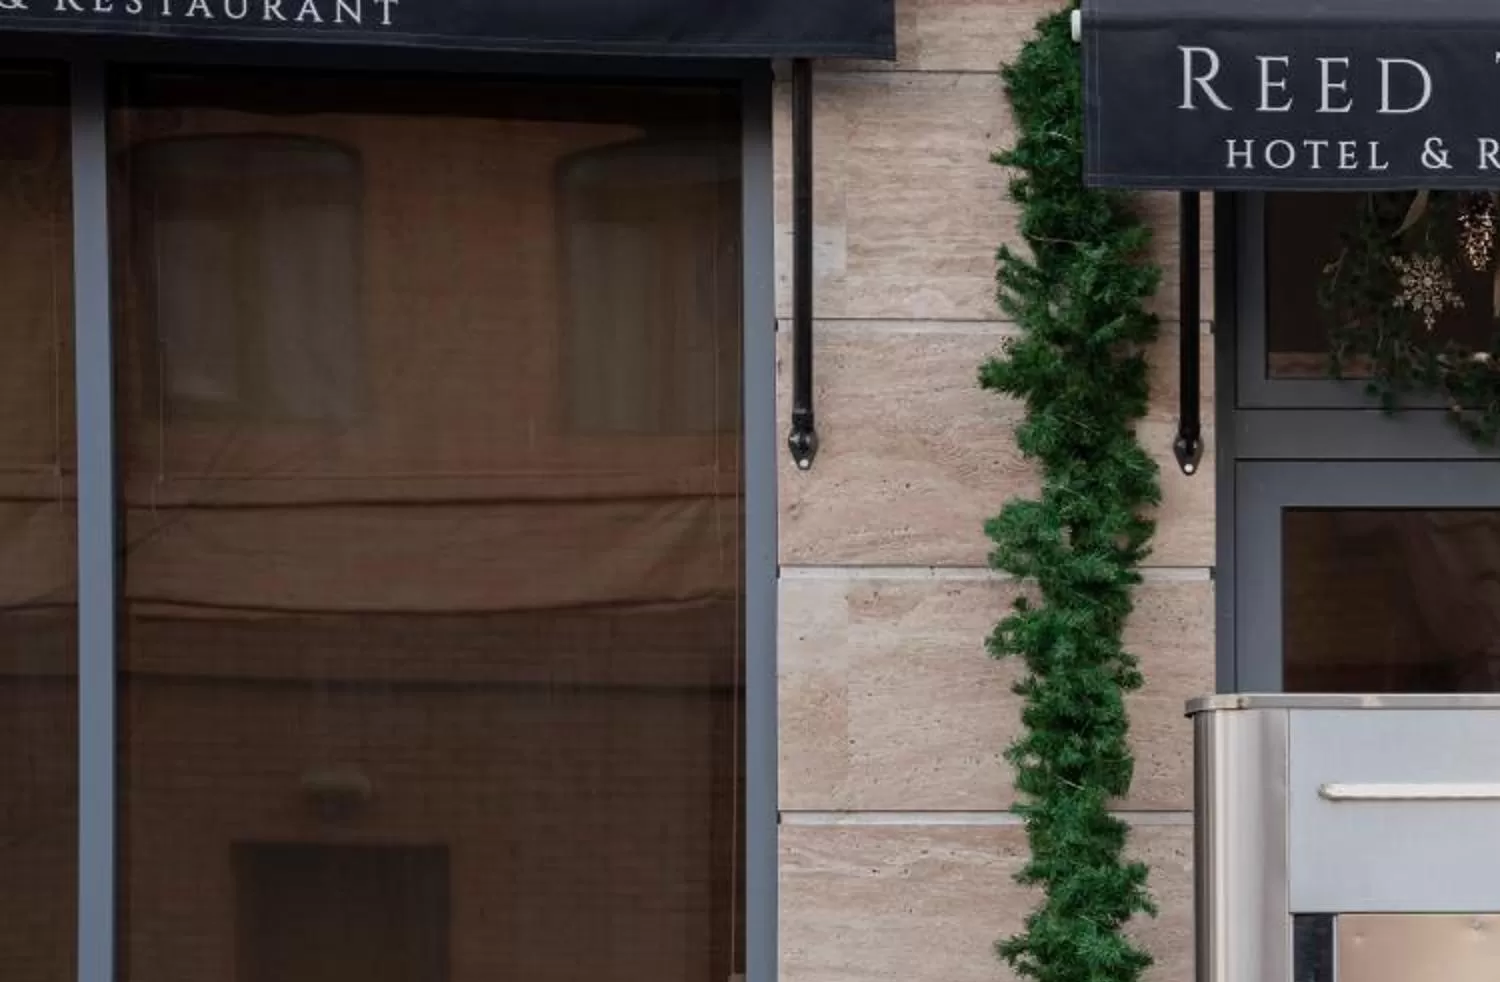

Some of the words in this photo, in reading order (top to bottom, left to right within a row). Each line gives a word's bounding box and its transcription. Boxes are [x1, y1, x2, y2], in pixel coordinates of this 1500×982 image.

[1177, 45, 1433, 115] REED
[1225, 139, 1389, 170] HOTEL
[1420, 136, 1453, 170] &
